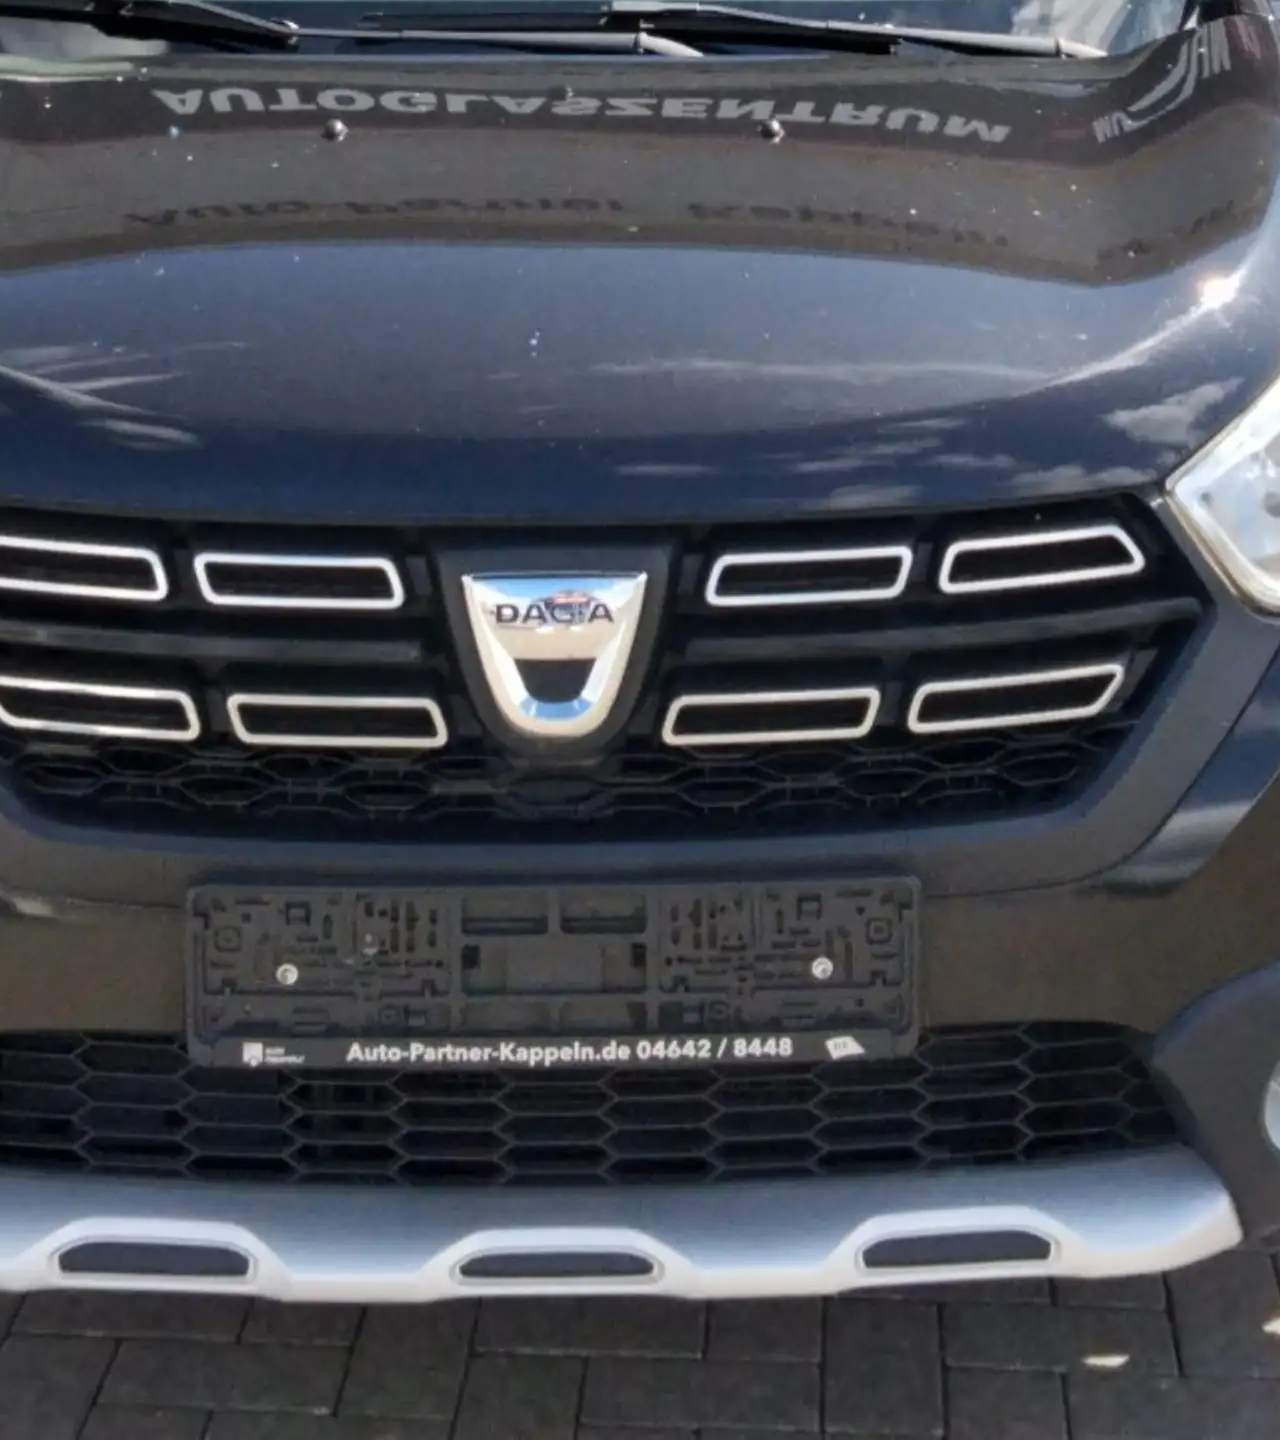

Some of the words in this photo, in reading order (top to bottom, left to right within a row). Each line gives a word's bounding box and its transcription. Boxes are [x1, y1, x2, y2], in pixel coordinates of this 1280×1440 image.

[346, 1039, 632, 1067] Auto-Partner-Kappeln.de
[636, 1038, 712, 1060] 04642
[733, 1037, 793, 1058] 8448
